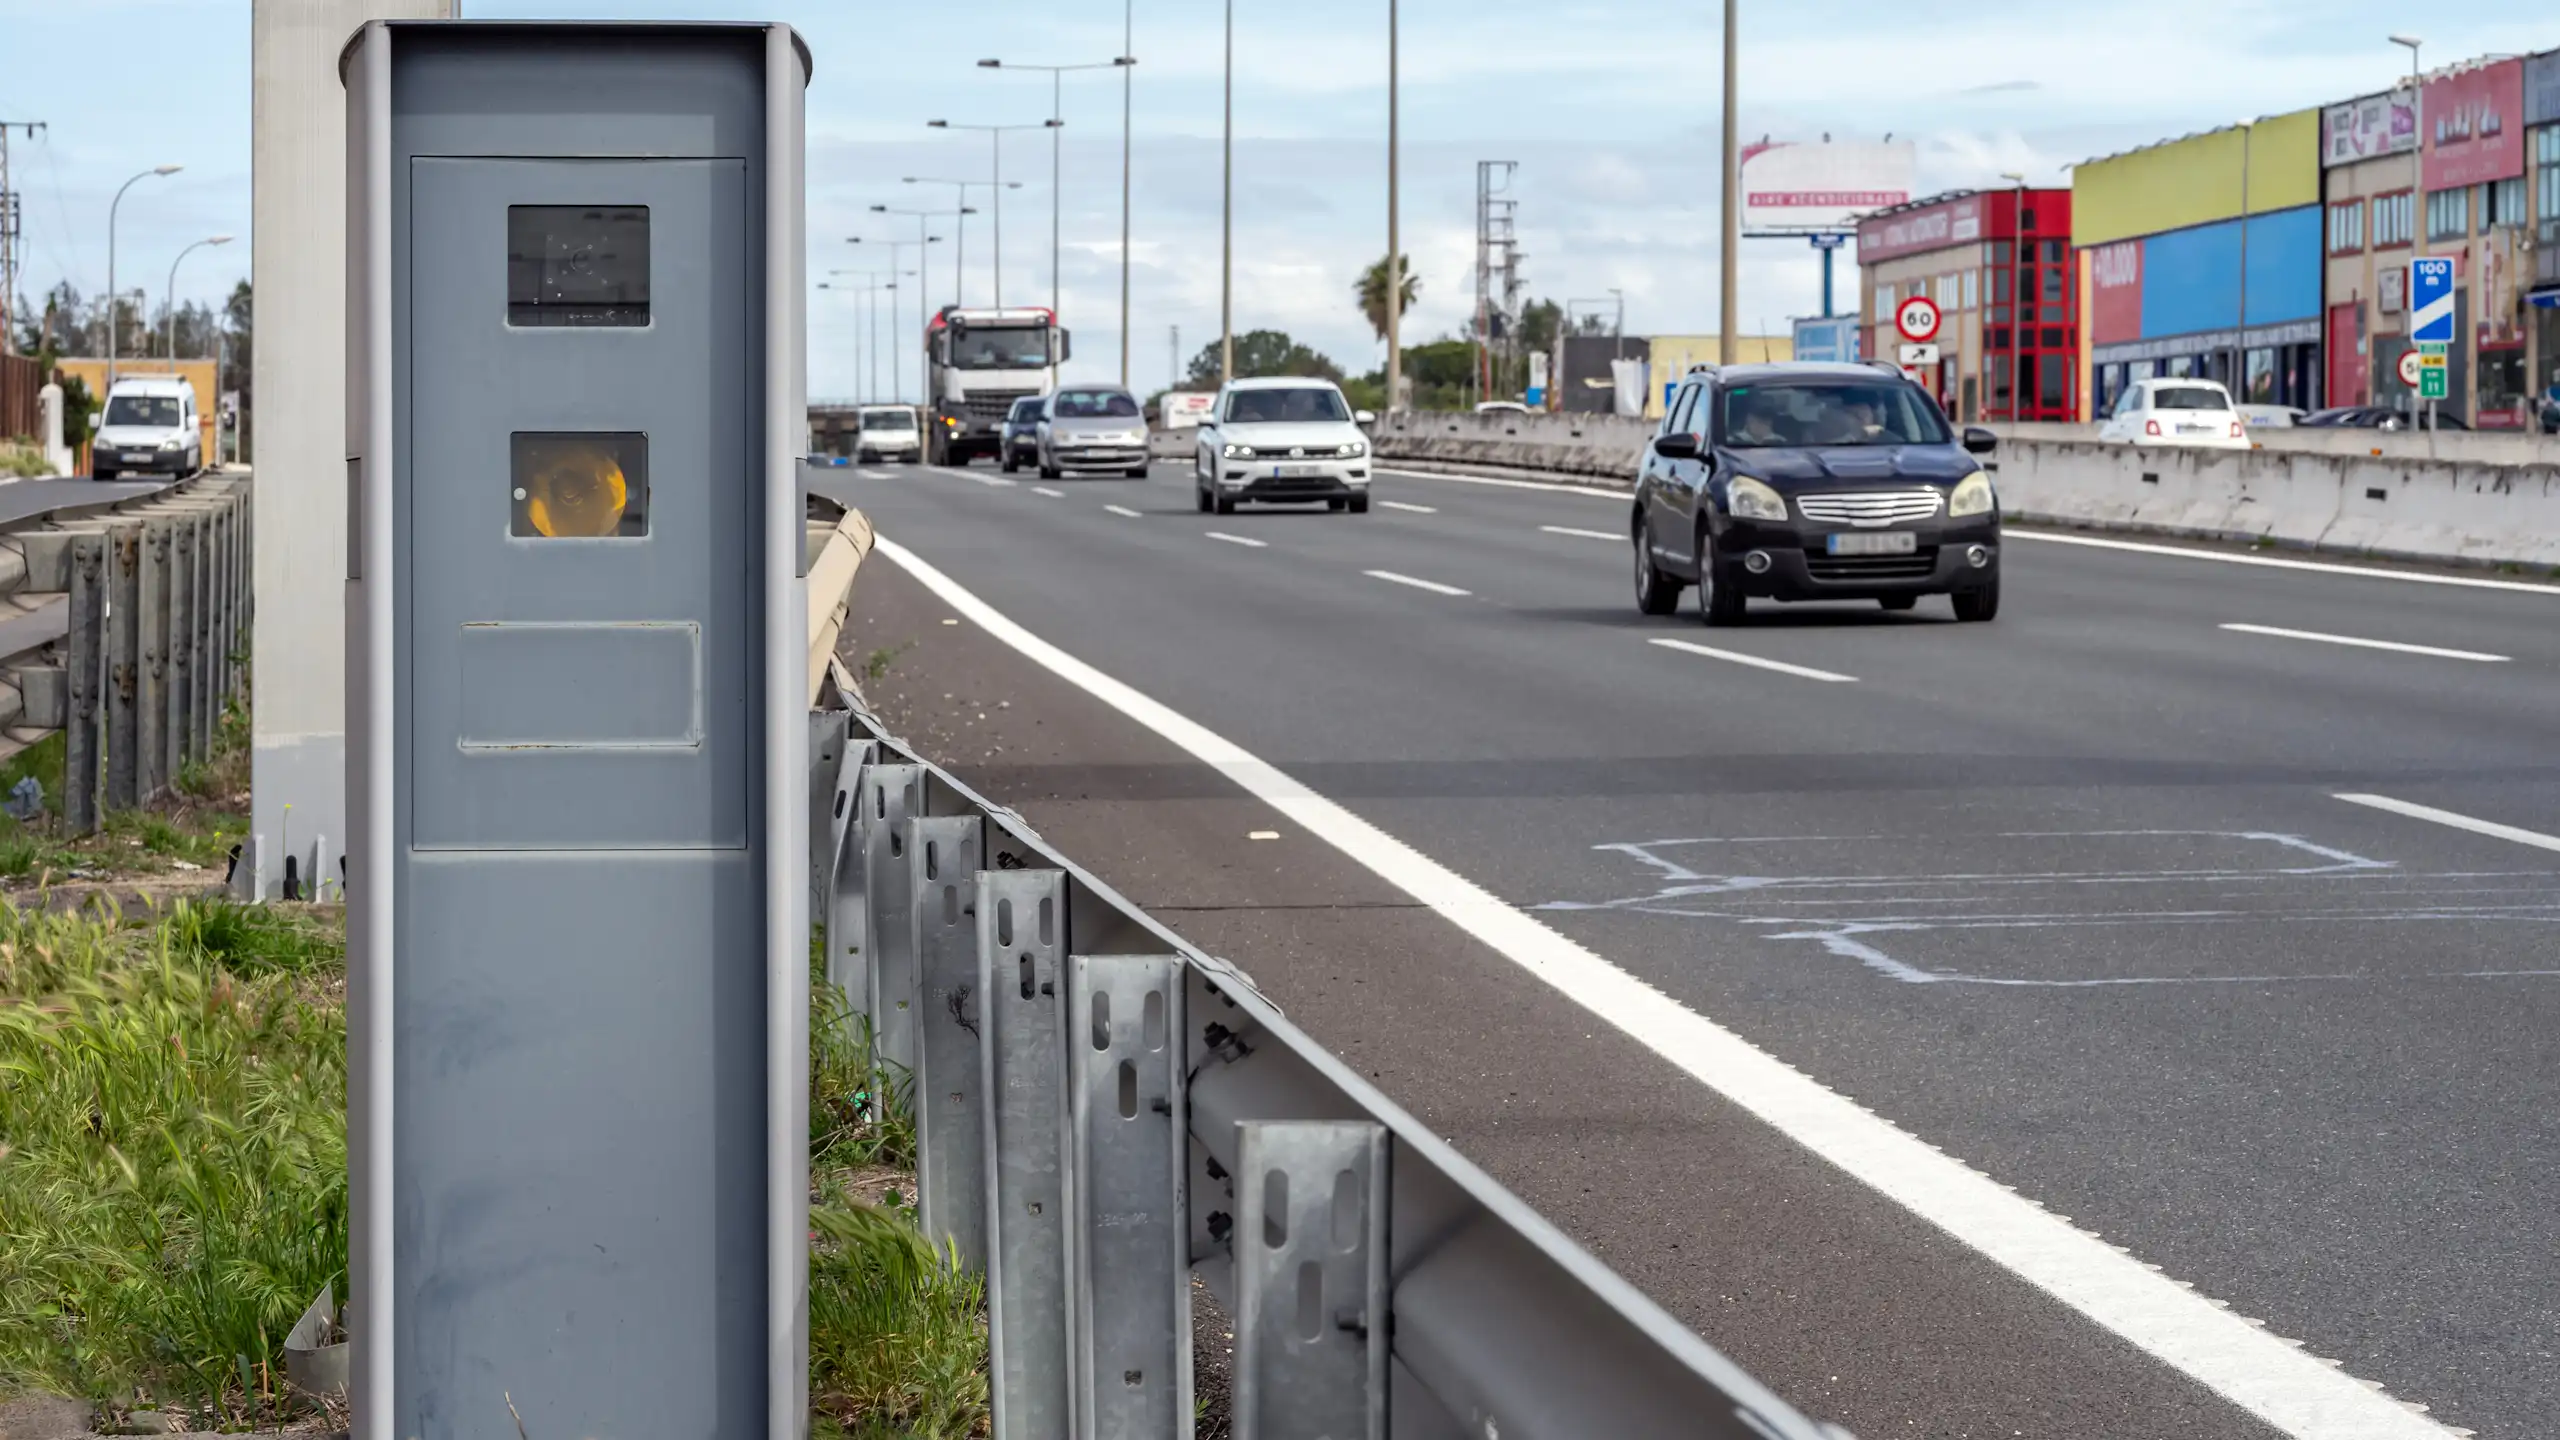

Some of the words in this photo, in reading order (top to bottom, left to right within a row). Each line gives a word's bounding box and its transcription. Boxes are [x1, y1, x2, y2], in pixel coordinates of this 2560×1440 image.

[1751, 193, 1783, 205] AIRE
[2419, 262, 2447, 274] 100
[1907, 312, 1931, 327] 60
